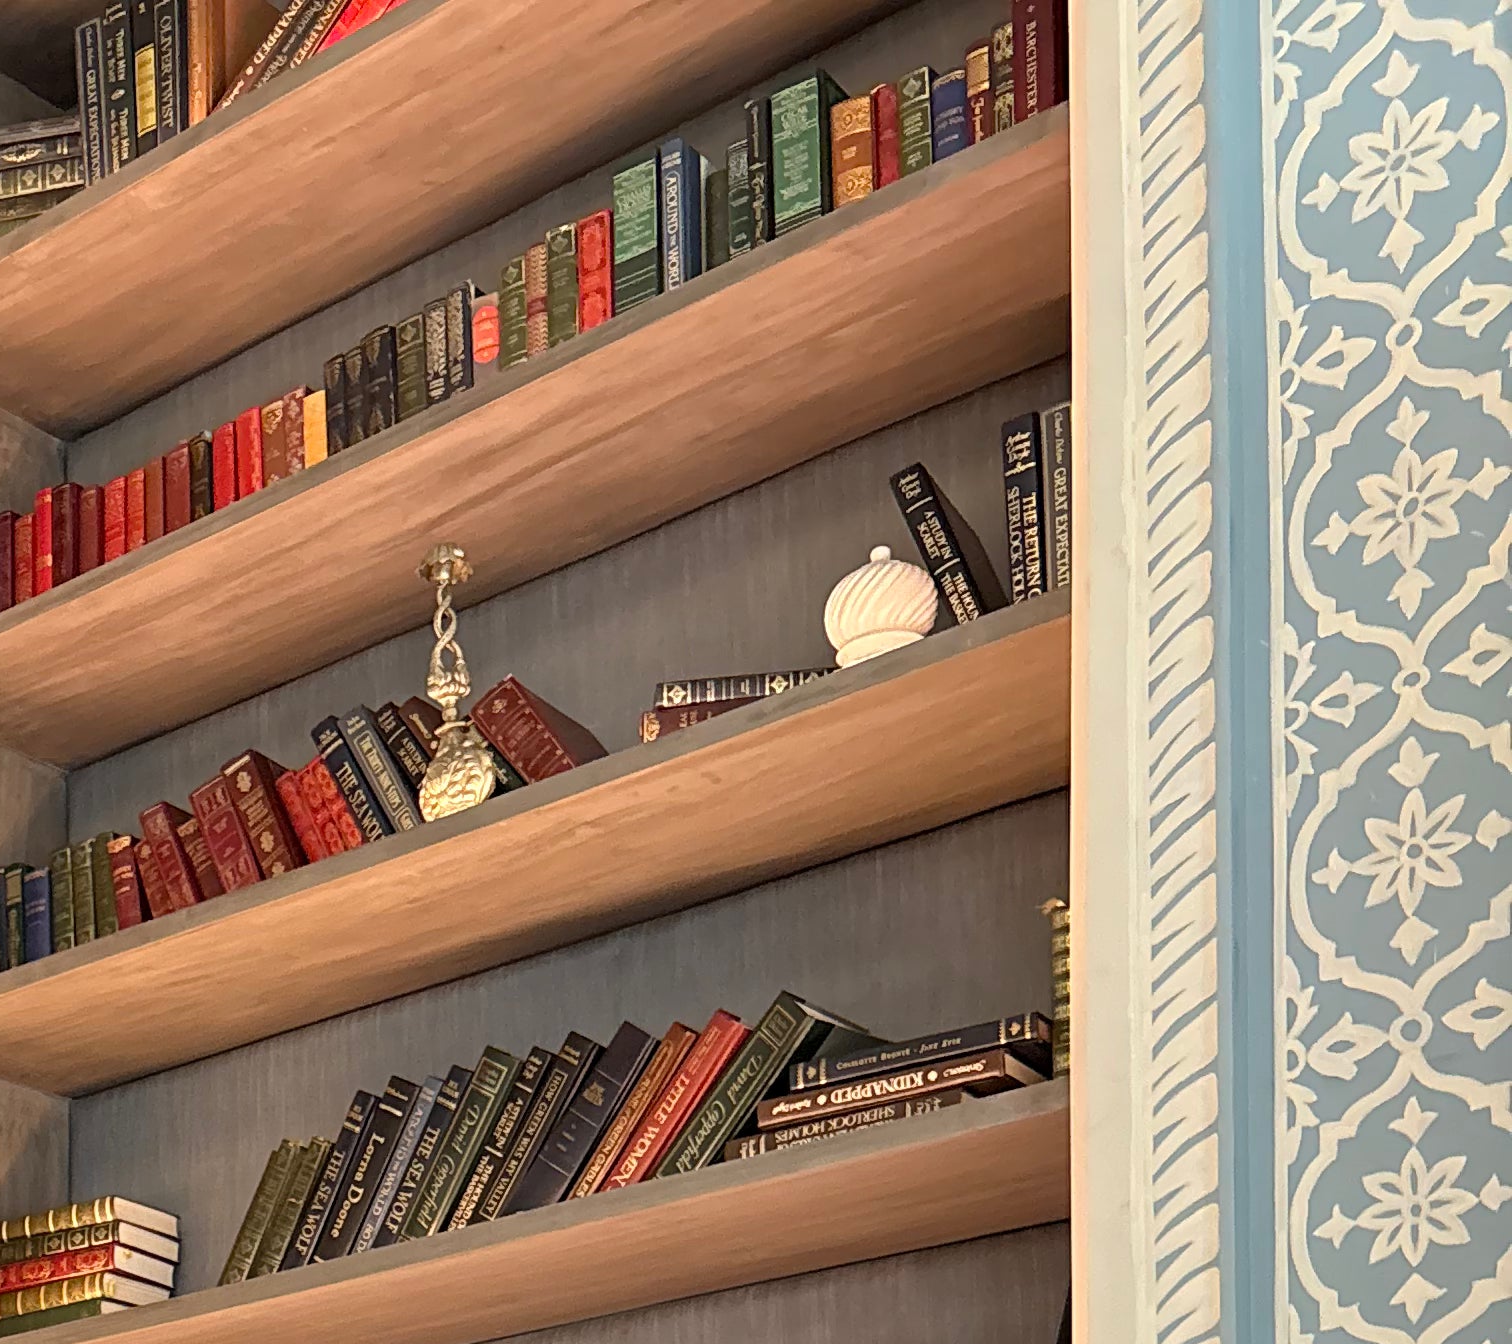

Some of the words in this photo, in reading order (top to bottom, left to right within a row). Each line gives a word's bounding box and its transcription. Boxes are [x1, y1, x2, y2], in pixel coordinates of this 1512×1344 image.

[160, 15, 173, 78] OLIVER
[253, 0, 306, 64] DNAPPED
[1025, 20, 1038, 108] BARCHESTER
[86, 69, 97, 103] GREAT
[161, 77, 174, 128] TWIST
[665, 177, 679, 235] AROUND
[667, 250, 681, 291] WORL
[1053, 467, 1068, 512] GREAT
[924, 511, 935, 520] A
[1007, 486, 1023, 565] SHERLOCK
[1022, 491, 1037, 528] THE
[917, 521, 940, 560] SCARLET
[928, 519, 948, 548] STUDY
[940, 546, 954, 560] IN
[1056, 513, 1070, 588] EXPECTATI
[1024, 528, 1042, 589] RETURN
[940, 572, 955, 597] THE
[953, 571, 968, 596] THE
[1012, 565, 1025, 605] HOL
[335, 761, 358, 795] THE
[349, 789, 370, 819] SEA
[362, 809, 385, 842] WOL
[385, 785, 402, 809] STEPS
[545, 1073, 562, 1102] HOW
[629, 1077, 652, 1111] ANNE
[726, 1053, 763, 1105] David
[829, 1070, 925, 1104] KIDNAPPED
[657, 1073, 691, 1125] LITTLE
[829, 1105, 896, 1130] SHERLOCK
[451, 1104, 480, 1155] David
[530, 1102, 549, 1136] GREEN
[603, 1113, 628, 1152] GREEN
[675, 1100, 725, 1174] Copperfield
[775, 1119, 827, 1144] HOLMES
[353, 1132, 386, 1182] Lorna
[416, 1126, 441, 1159] THE
[516, 1136, 531, 1160] WAS
[611, 1124, 661, 1188] WOMEN
[328, 1149, 346, 1182] THE
[402, 1158, 425, 1189] SEA
[475, 1154, 489, 1177] THE
[482, 1163, 495, 1185] THE
[506, 1157, 520, 1174] MY
[576, 1150, 606, 1198] GABLES
[312, 1181, 332, 1212] SEA
[330, 1182, 365, 1239] Doone
[417, 1154, 456, 1229] Copperfield
[448, 1175, 478, 1232] BASKERVILLE
[463, 1182, 485, 1221] HOUND
[486, 1176, 511, 1214] VALLEY
[385, 1189, 414, 1235] WOLF
[294, 1211, 321, 1256] WOLF
